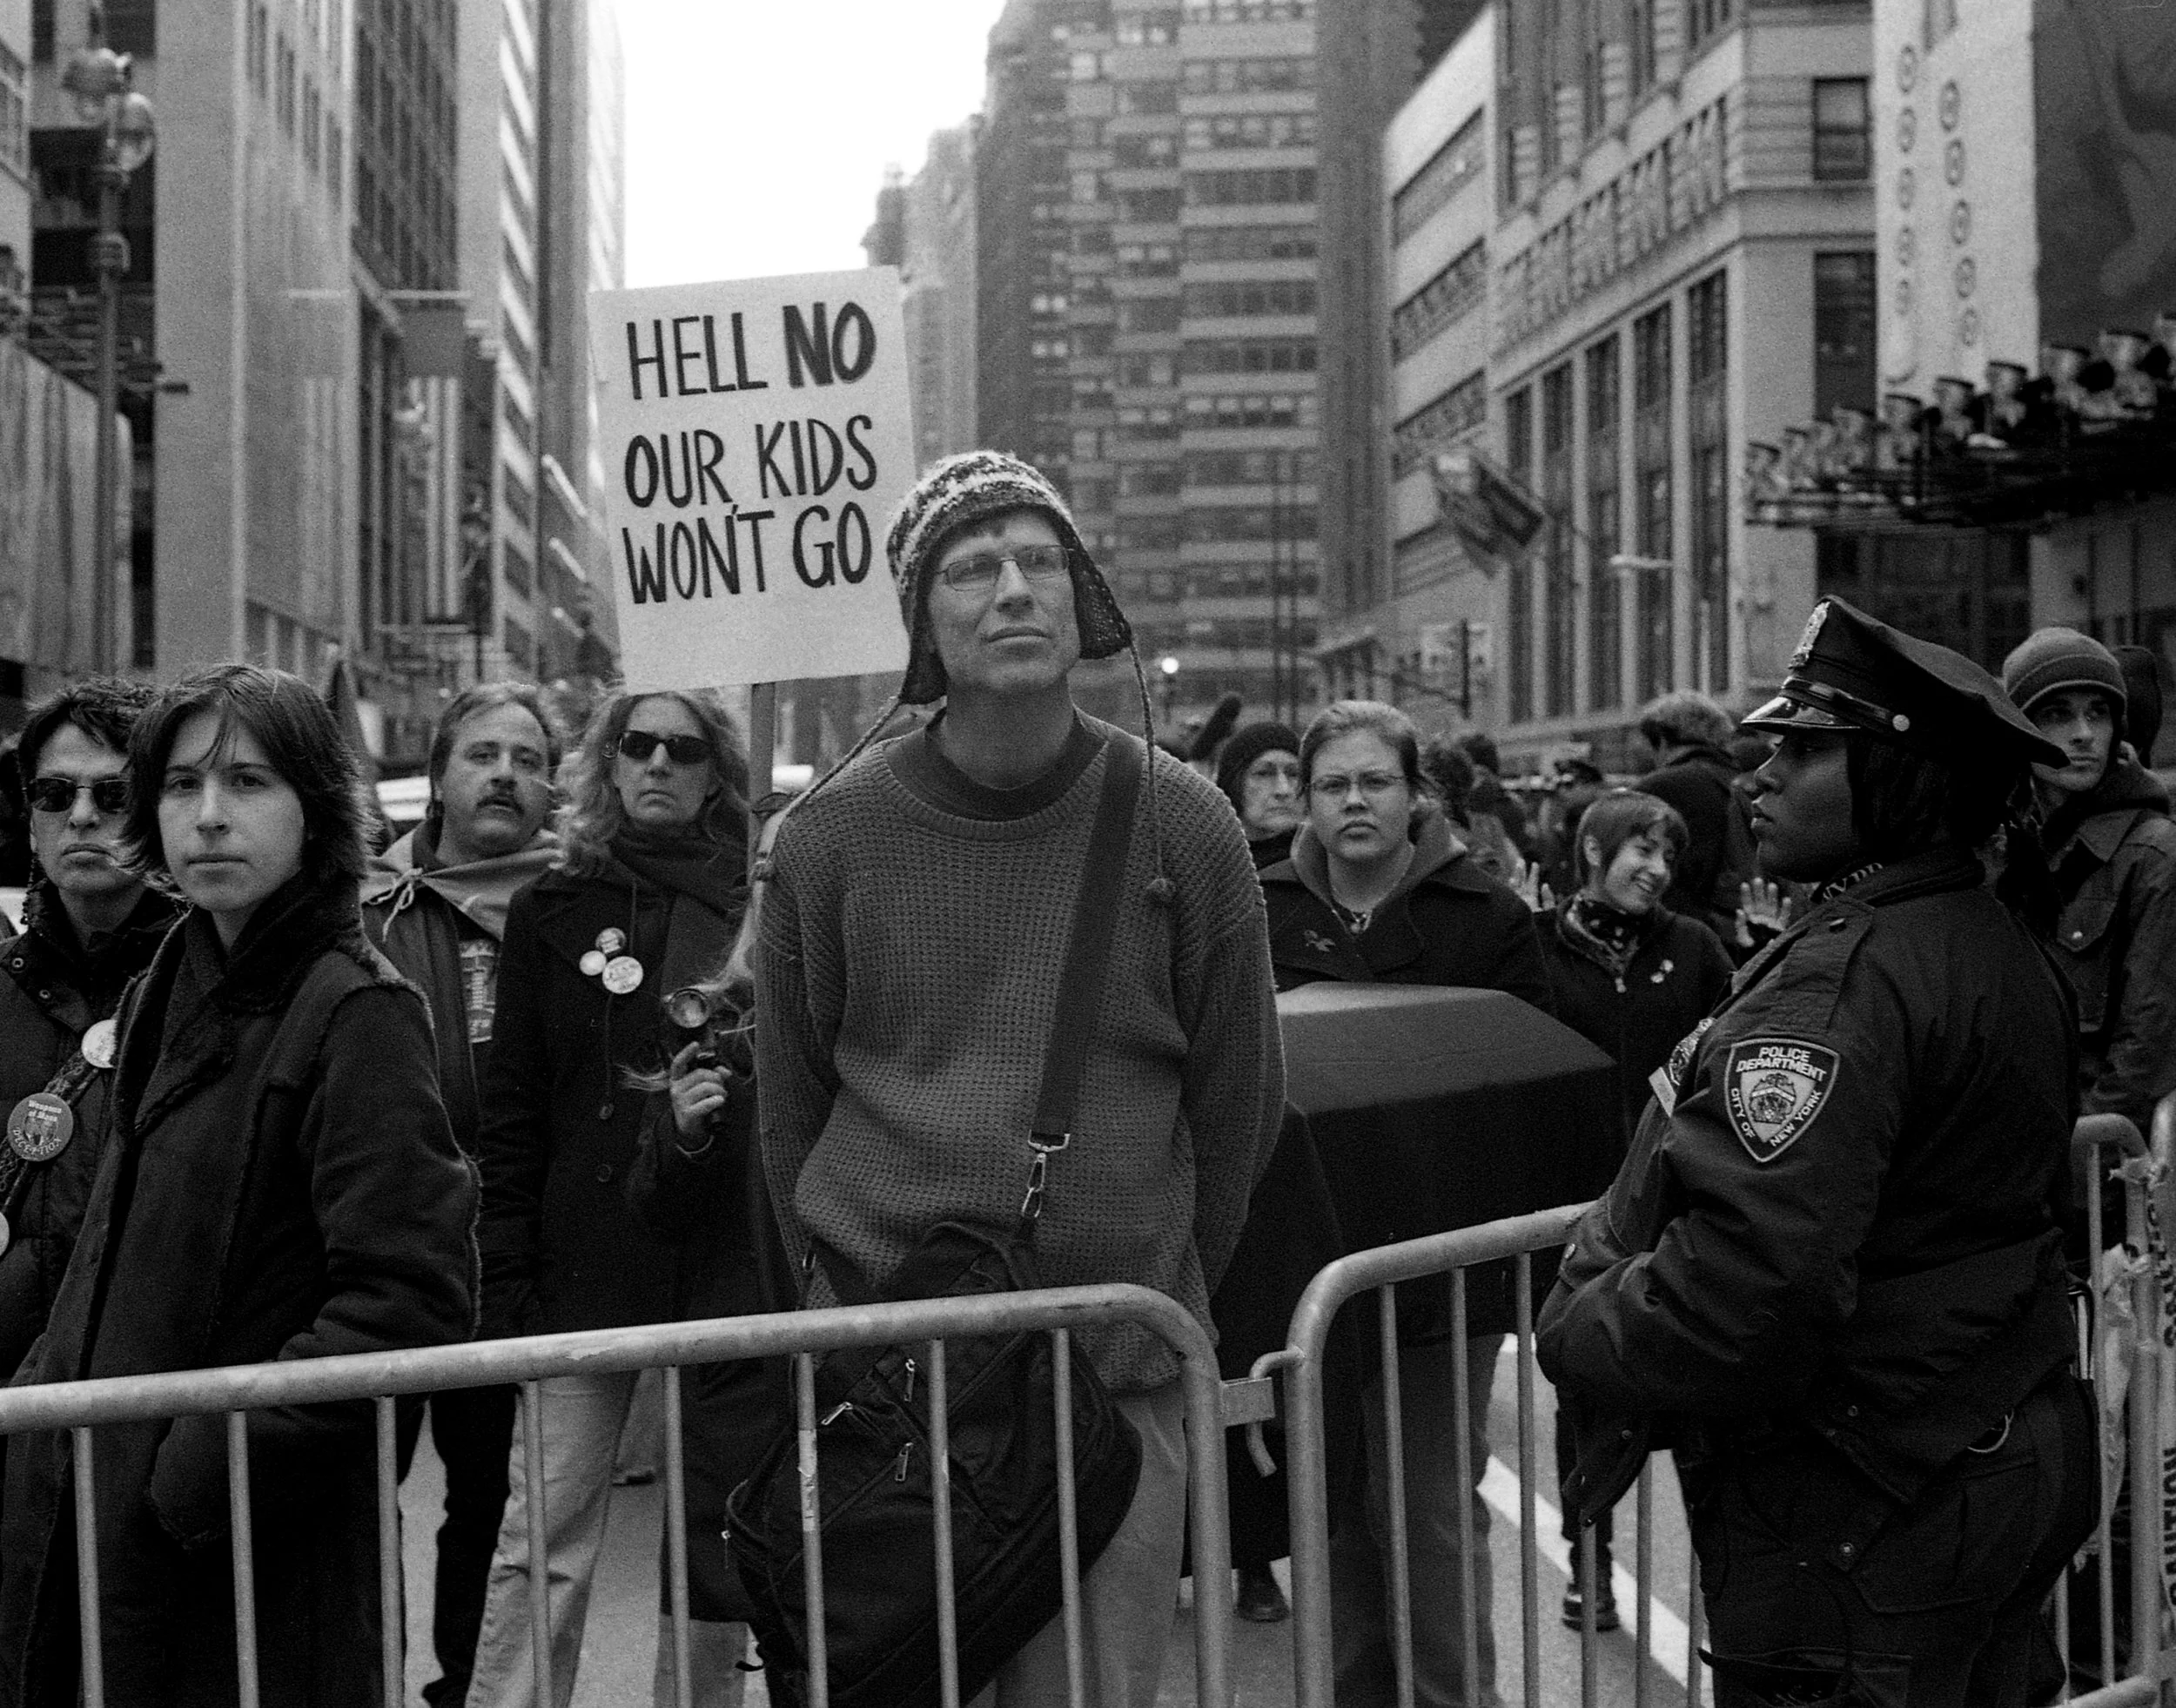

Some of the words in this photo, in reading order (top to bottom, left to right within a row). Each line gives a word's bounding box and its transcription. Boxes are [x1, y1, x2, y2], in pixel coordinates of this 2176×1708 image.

[626, 312, 769, 400] HELL
[782, 301, 876, 388] NO
[624, 429, 733, 508] OUR
[755, 414, 877, 499] KIDS
[622, 505, 775, 604] WON'T
[792, 501, 872, 588] GO
[1736, 1058, 1827, 1082] DEPARTMENT
[1758, 1046, 1810, 1063] POLICE
[1731, 1088, 1746, 1118] CITY
[1741, 1121, 1756, 1138] OF
[1770, 1123, 1796, 1147] NEW
[1795, 1090, 1822, 1121] YORK
